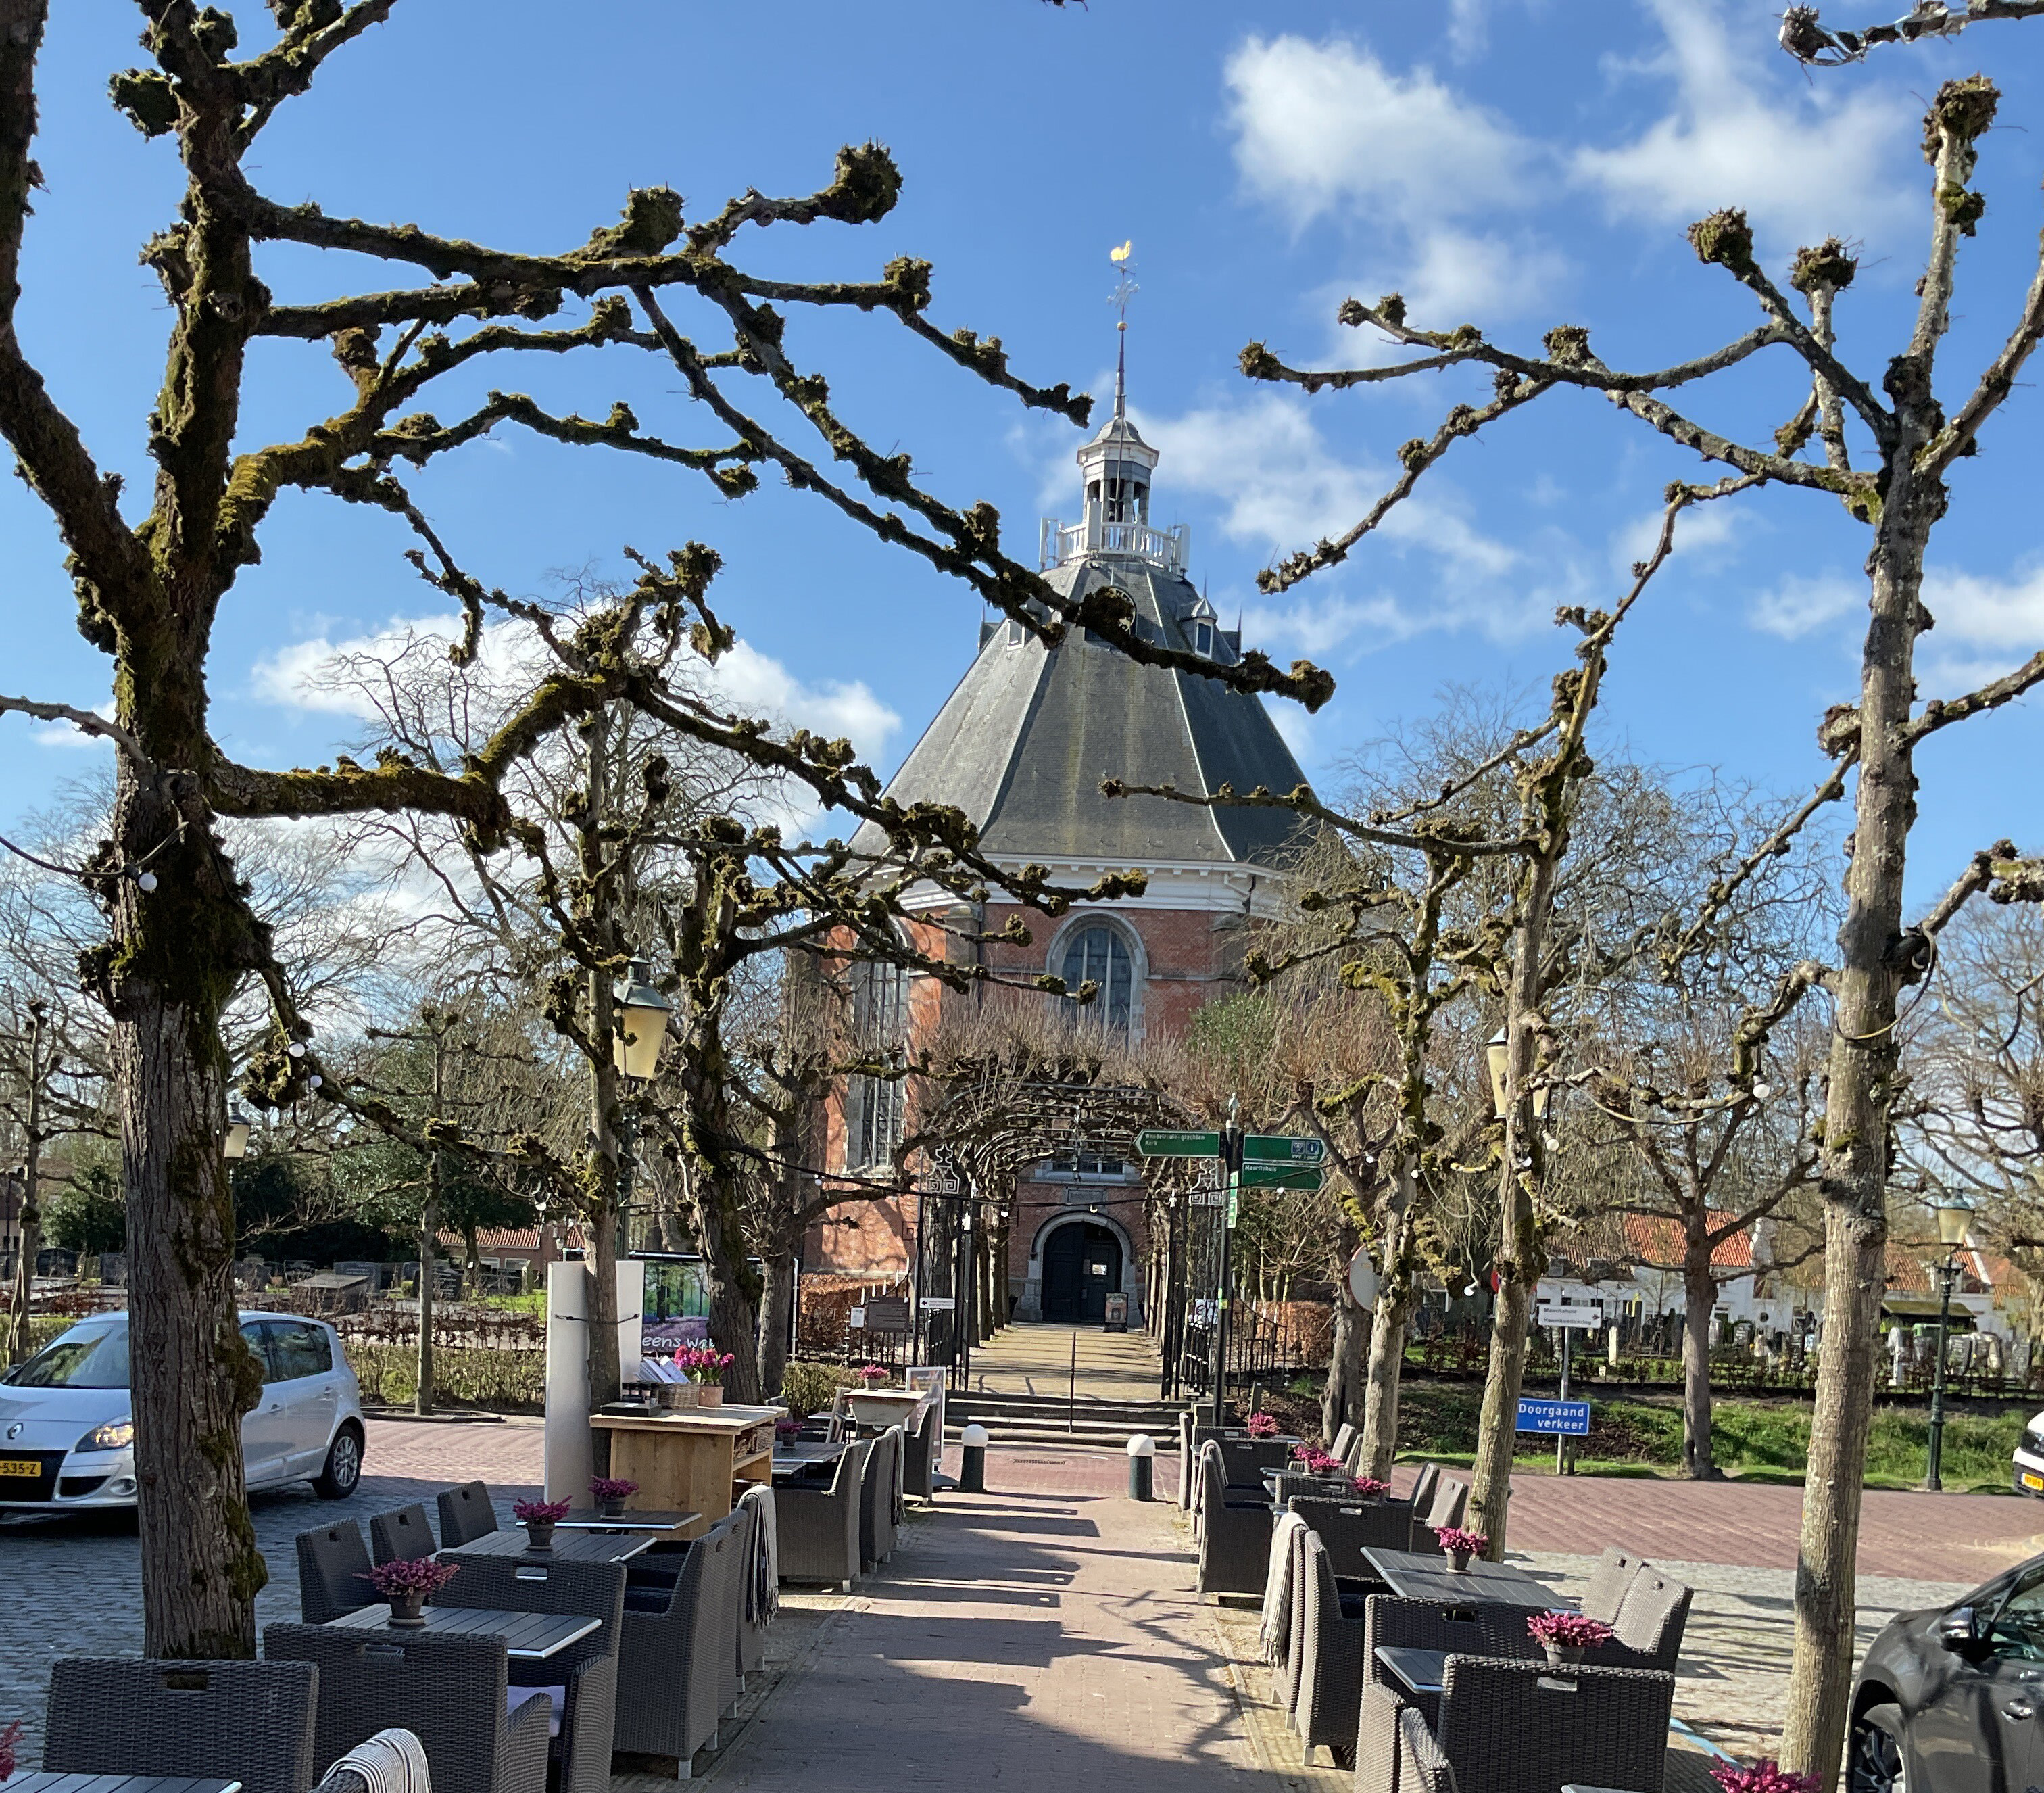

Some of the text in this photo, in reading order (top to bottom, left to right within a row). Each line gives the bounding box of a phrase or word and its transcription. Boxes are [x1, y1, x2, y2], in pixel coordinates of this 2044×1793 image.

[1244, 1164, 1277, 1172] Mauritshuis
[1518, 1404, 1584, 1418] Doorgaand
[1537, 1418, 1584, 1430] verkeer
